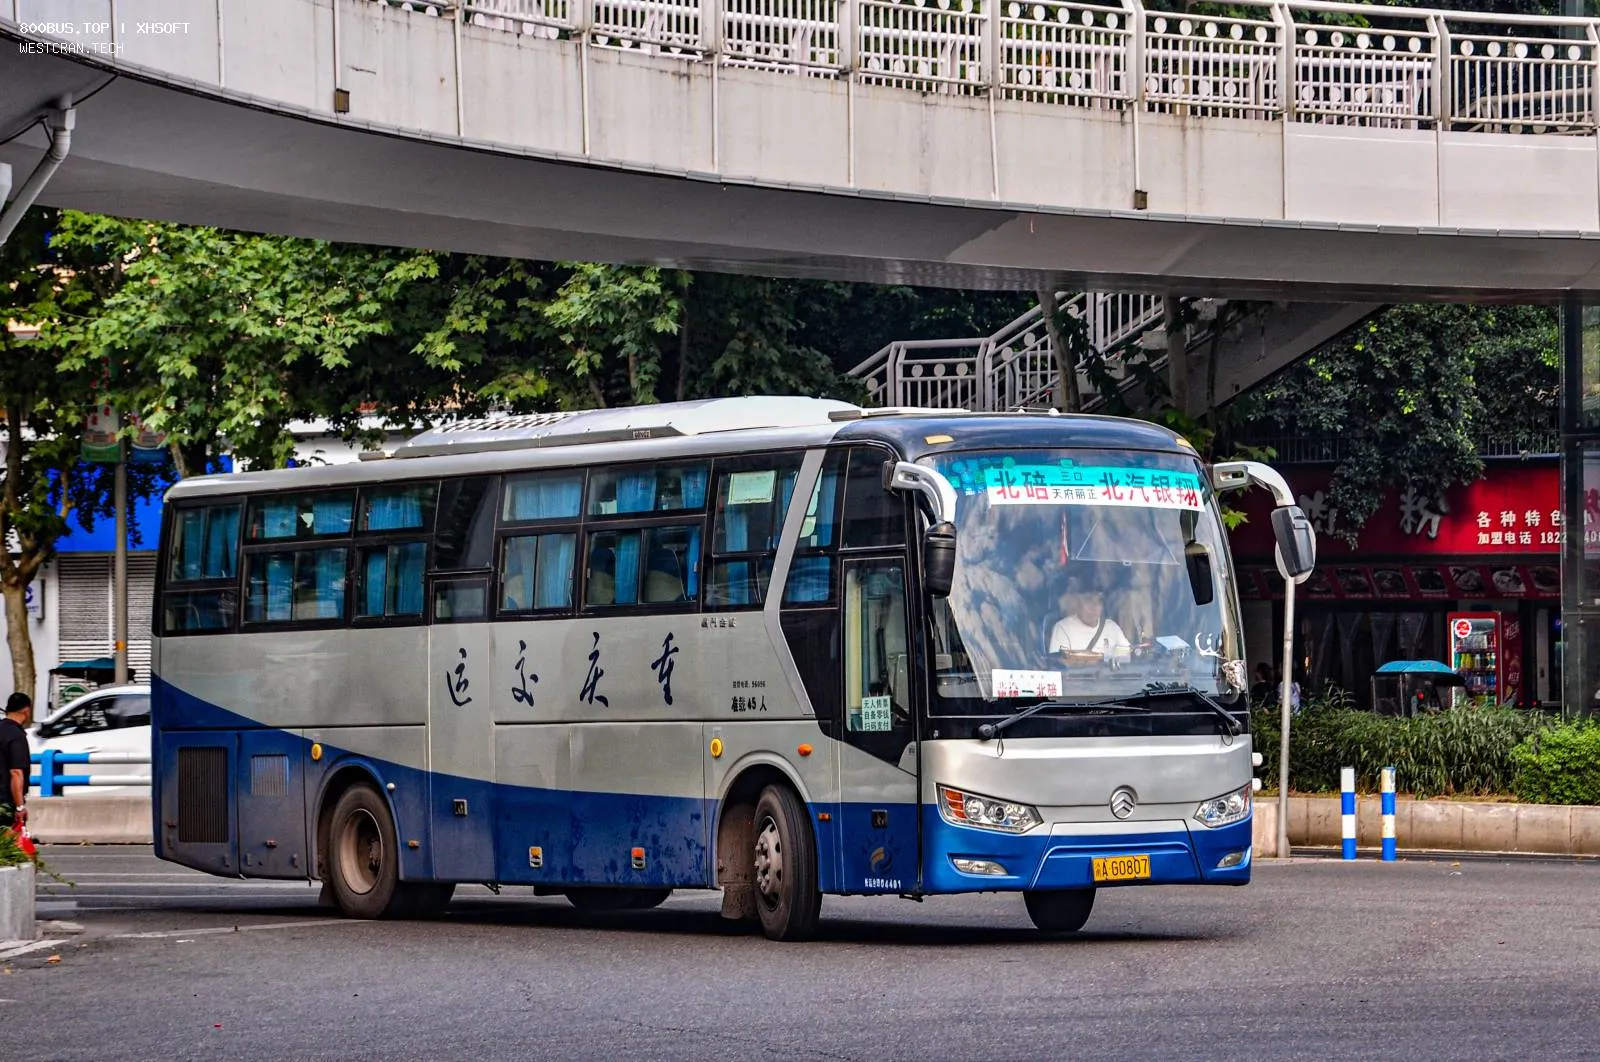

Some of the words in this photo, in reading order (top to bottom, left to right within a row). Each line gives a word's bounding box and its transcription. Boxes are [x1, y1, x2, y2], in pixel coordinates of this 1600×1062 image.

[994, 470, 1048, 500] 北碚
[1099, 471, 1199, 507] 北汽银翔
[1478, 531, 1532, 545] 加盟电话
[864, 710, 889, 720] 自备零钱
